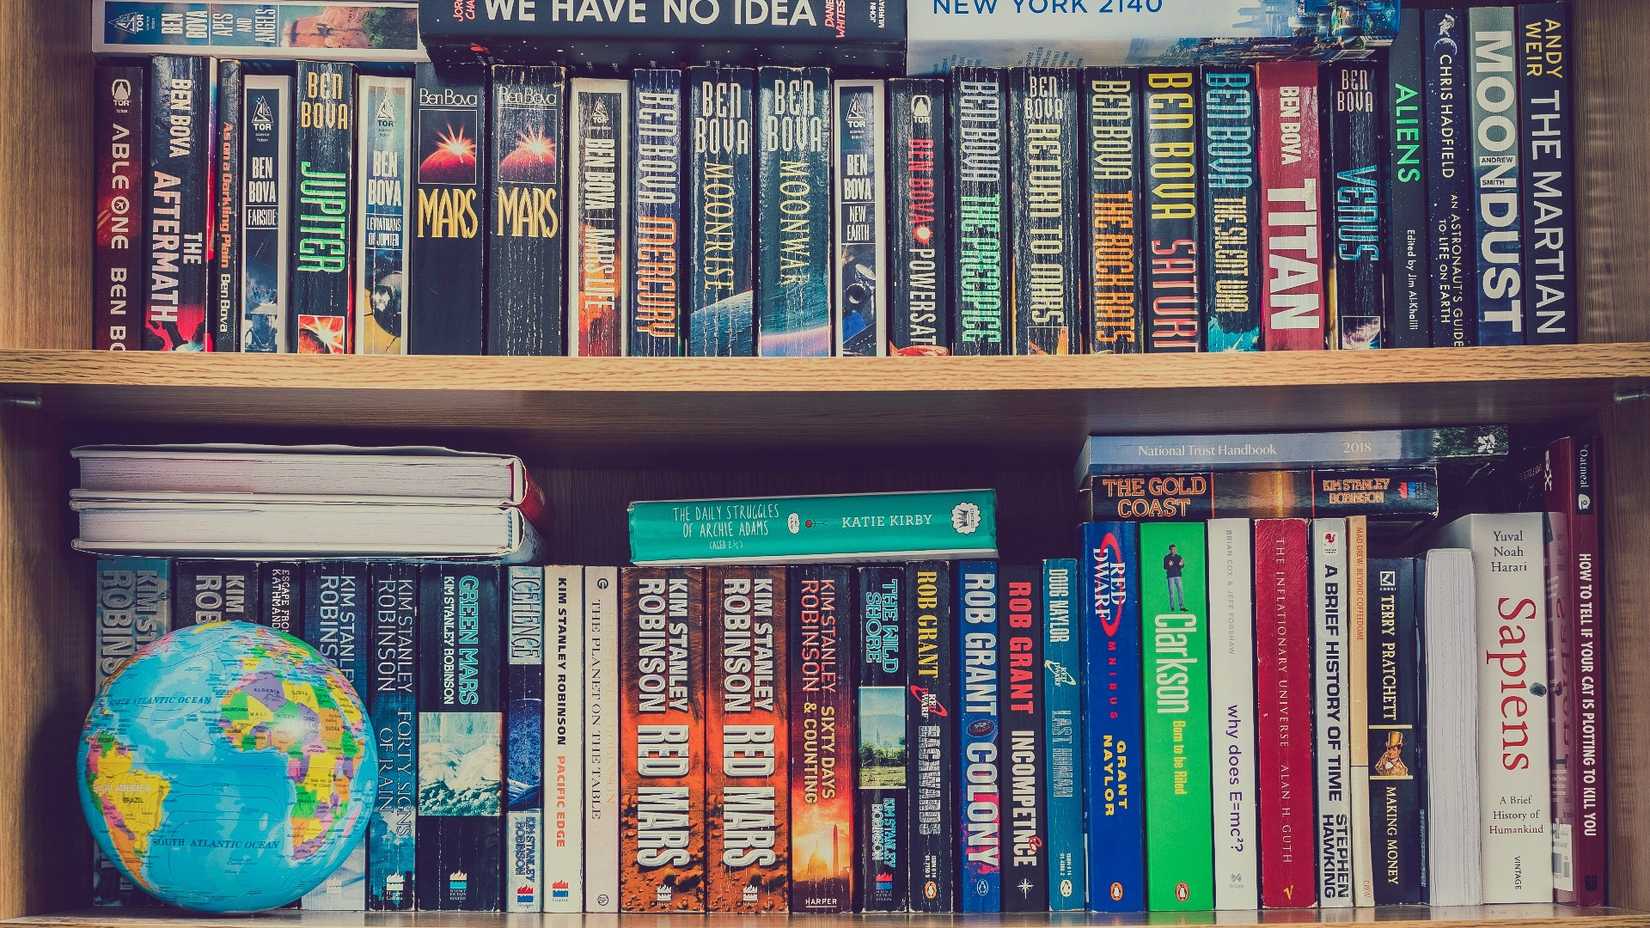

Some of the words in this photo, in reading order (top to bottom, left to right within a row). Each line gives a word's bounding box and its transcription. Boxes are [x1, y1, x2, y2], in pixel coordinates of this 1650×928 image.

[161, 13, 183, 34] BEN
[186, 10, 208, 39] BOVA
[212, 12, 233, 37] APES
[236, 18, 252, 33] AND
[255, 8, 275, 43] ANGELS
[485, 0, 535, 21] WE
[552, 0, 646, 22] HAVE
[663, 0, 719, 24] NO
[735, 0, 816, 26] IDEA
[1525, 22, 1544, 78] WEIR
[1544, 18, 1565, 80] ANDY
[169, 79, 193, 111] BEN
[1440, 54, 1454, 102] CHRIS
[168, 115, 192, 158] BOVA
[1395, 83, 1422, 185] ALIENS
[1441, 104, 1456, 180] HADFIELD
[1530, 90, 1561, 162] THE
[111, 123, 130, 189] ABLE
[252, 157, 273, 179] BEN
[1027, 124, 1062, 218] RETURN
[1482, 157, 1514, 166] ANDREW
[1450, 194, 1460, 210] AN
[1474, 30, 1522, 334] MOONDUST
[1482, 179, 1506, 188] SMITH
[111, 196, 130, 249] ONE
[248, 209, 278, 227] FARSIDE
[297, 161, 346, 272] JUPITER
[417, 188, 479, 239] MARS
[497, 187, 559, 239] MARS
[703, 161, 736, 292] MOONRISE
[779, 159, 810, 289] MOONWAR
[850, 206, 866, 222] NEW
[960, 193, 1001, 232] THE
[1093, 191, 1135, 229] THE
[1214, 196, 1248, 223] THE
[1336, 164, 1380, 261] VENUS
[1438, 218, 1448, 233] TO
[151, 171, 182, 322] AFTERMATH
[183, 232, 204, 264] THE
[585, 228, 616, 274] MARS
[847, 225, 870, 241] EARTH
[1030, 224, 1063, 256] TO
[1214, 227, 1249, 277] SILENT
[1266, 178, 1320, 331] TITAN
[1406, 228, 1418, 255] Edited
[1439, 237, 1451, 260] LIFE
[1532, 171, 1567, 336] MARTIAN
[635, 215, 677, 339] MERCURY
[1094, 234, 1135, 287] ROCK
[1404, 259, 1417, 272] by
[1439, 264, 1449, 281] ON
[1451, 214, 1465, 303] ASTRONAUT'S
[584, 276, 616, 311] LIFE
[908, 248, 936, 344] POWERSAT
[960, 238, 1002, 343] PRECIPICE
[1030, 264, 1065, 324] MARS
[1215, 280, 1249, 313] WAR
[1407, 274, 1418, 288] Jim
[1096, 291, 1136, 344] RATS
[1407, 292, 1419, 331] Al-Khalili
[1440, 284, 1453, 324] EARTH
[1453, 308, 1466, 348] GUIDE
[1138, 445, 1186, 458] National
[1188, 444, 1216, 457] Trust
[1218, 442, 1278, 456] Handbook
[1343, 439, 1373, 455] 2018
[1102, 479, 1146, 498] THE
[1148, 477, 1207, 496] GOLD
[1580, 449, 1591, 489] Oatmeal
[673, 507, 691, 522] THE
[695, 505, 722, 521] DAILY
[726, 503, 779, 520] STRUGGLES
[682, 522, 696, 538] OF
[700, 521, 734, 537] ARCHIE
[739, 519, 769, 536] ADAMS
[841, 515, 887, 529] KATIE
[890, 514, 933, 527] KIRBY
[1118, 498, 1191, 518] COAST
[1275, 538, 1286, 566] THE
[1493, 530, 1524, 545] Yuval
[1494, 546, 1525, 561] Noah
[443, 576, 455, 595] KIM
[1048, 568, 1068, 598] DOUG
[1093, 548, 1115, 621] DWARF
[1109, 561, 1128, 605] RED
[1323, 564, 1337, 578] A
[1491, 561, 1528, 577] Harari
[1579, 553, 1593, 583] HOW
[225, 575, 245, 614] KIM
[459, 575, 480, 643] GREEN
[557, 577, 567, 603] KIM
[880, 579, 898, 622] THE
[917, 571, 937, 609] ROB
[964, 573, 996, 625] ROB
[1325, 582, 1339, 637] BRIEF
[1580, 585, 1593, 599] TO
[443, 597, 455, 645] STANLEY
[511, 576, 541, 659] ICEHENGE
[591, 599, 602, 633] THE
[865, 591, 884, 664] SHORE
[1049, 600, 1071, 644] NAYLOR
[1275, 571, 1289, 675] INFLATIONARY
[1381, 595, 1396, 637] TERRY
[1580, 602, 1593, 625] TELL
[1581, 629, 1593, 638] IF
[557, 607, 568, 670] STANLEY
[881, 624, 899, 674] WILD
[917, 614, 939, 679] GRANT
[1582, 641, 1595, 673] YOUR
[443, 648, 455, 705] ROBINSON
[459, 649, 480, 705] MARS
[591, 637, 602, 700] PLANET
[965, 631, 997, 716] GRANT
[1154, 612, 1200, 715] Clarkson
[1325, 641, 1341, 722] HISTORY
[1382, 643, 1398, 720] PRATCHETT
[1486, 596, 1538, 771] Sapiens
[803, 701, 817, 714] &
[1583, 677, 1595, 698] CAT
[1583, 700, 1595, 710] IS
[557, 674, 567, 746] ROBINSON
[591, 704, 602, 725] ON
[821, 706, 836, 752] SIXTY
[1051, 709, 1073, 746] LAST
[1277, 680, 1290, 749] UNIVERSE
[379, 727, 396, 752] OF
[396, 711, 414, 774] FORTY
[591, 732, 602, 763] THE
[636, 723, 690, 777] RED
[722, 723, 776, 777] RED
[1326, 726, 1341, 753] OF
[1583, 713, 1597, 767] PLOTTING
[556, 755, 567, 806] PACIFIC
[803, 718, 820, 805] COUNTING
[821, 757, 837, 799] DAYS
[918, 725, 941, 835] BACKWARDS
[1103, 734, 1116, 818] NAYLOR
[1116, 740, 1129, 810] GRANT
[1327, 757, 1342, 802] TIME
[1584, 769, 1597, 785] TO
[378, 760, 396, 811] RAIN
[591, 768, 602, 821] TABLE
[966, 741, 998, 868] COLONY
[1500, 796, 1508, 806] A
[1511, 794, 1532, 806] Brief
[1584, 788, 1597, 811] KILL
[396, 783, 413, 838] SIGNS
[556, 811, 566, 848] EDGE
[636, 786, 690, 868] MARS
[722, 786, 776, 868] MARS
[1386, 786, 1399, 836] MAKING
[1489, 824, 1545, 838] Humankind
[1493, 810, 1527, 824] History
[1529, 810, 1541, 821] of
[1584, 813, 1598, 838] YOU
[1322, 815, 1336, 900] HAWKING
[1336, 814, 1349, 899] STEPHEN
[1387, 840, 1400, 885] MONEY
[805, 897, 838, 906] HARPER
